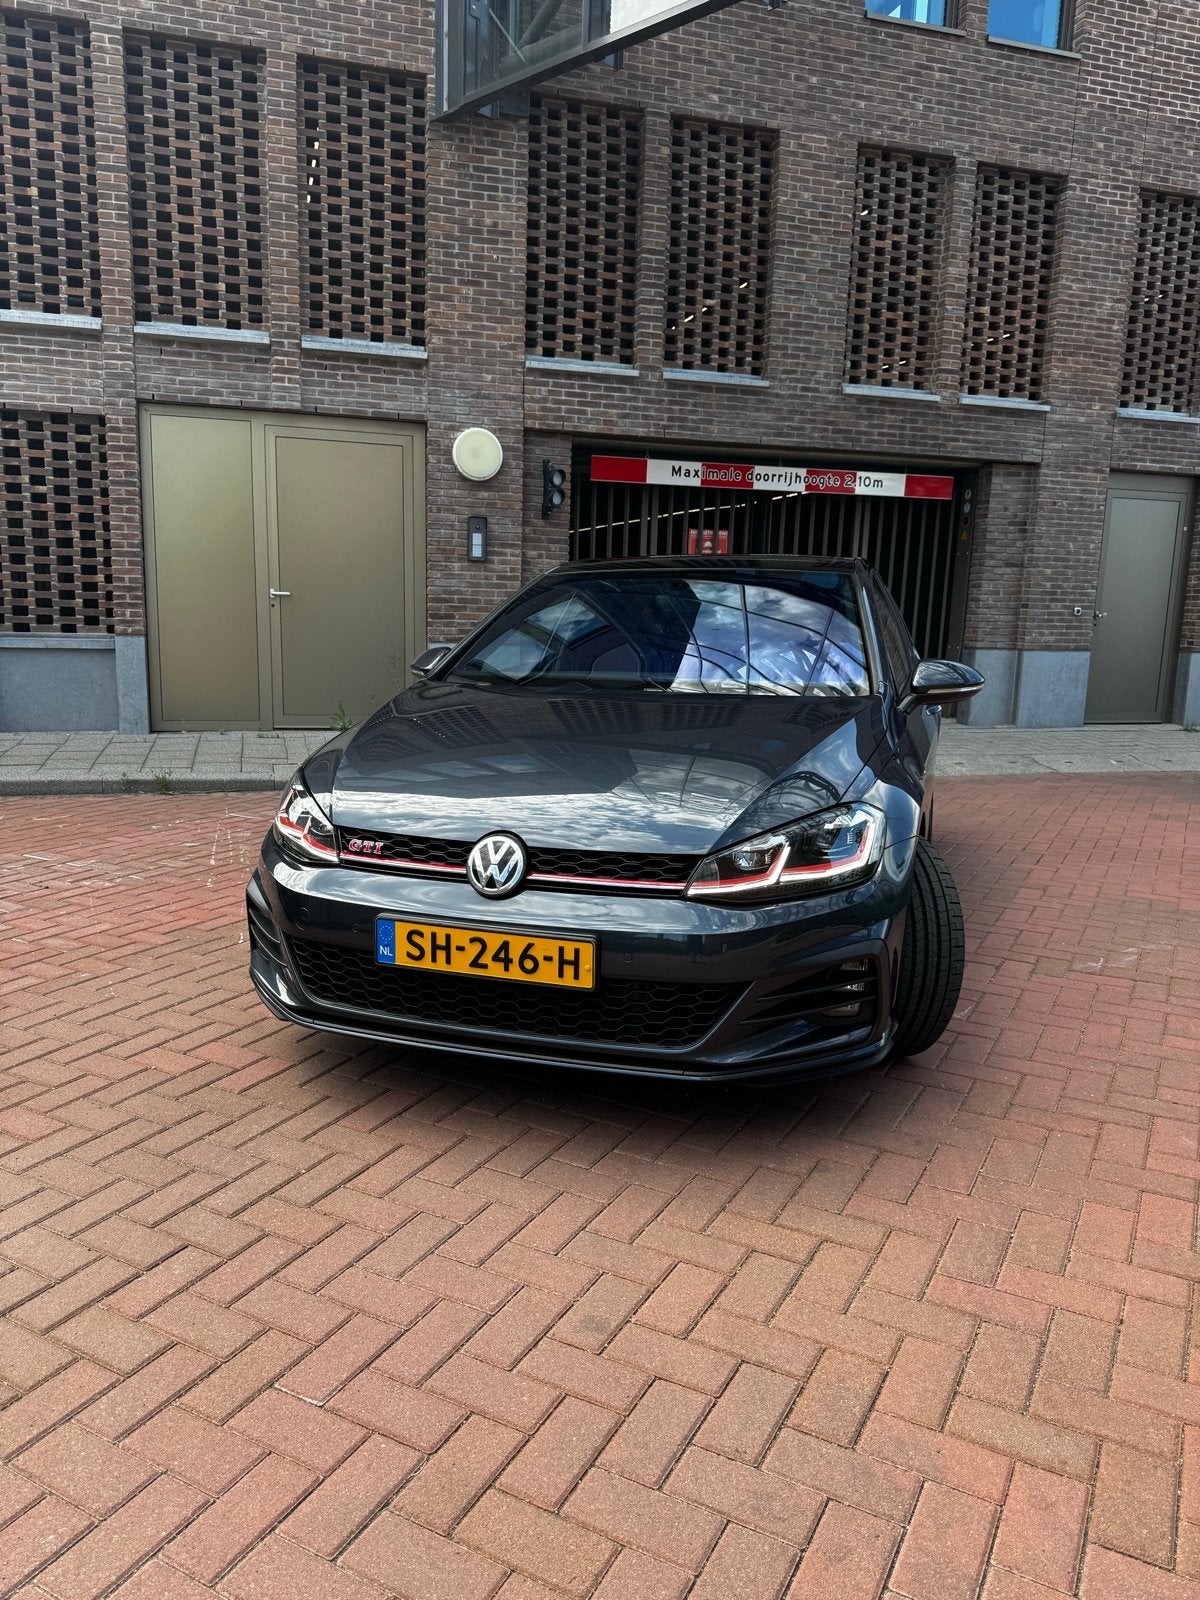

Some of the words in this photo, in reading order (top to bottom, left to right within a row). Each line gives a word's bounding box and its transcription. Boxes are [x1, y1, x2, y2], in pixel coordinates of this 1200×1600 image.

[671, 464, 742, 482] Maximale
[745, 468, 840, 490] doorrijhoogte
[844, 473, 884, 489] 2.10m
[348, 838, 384, 855] GTI
[379, 945, 394, 957] NL
[405, 928, 581, 981] SH-246-H
